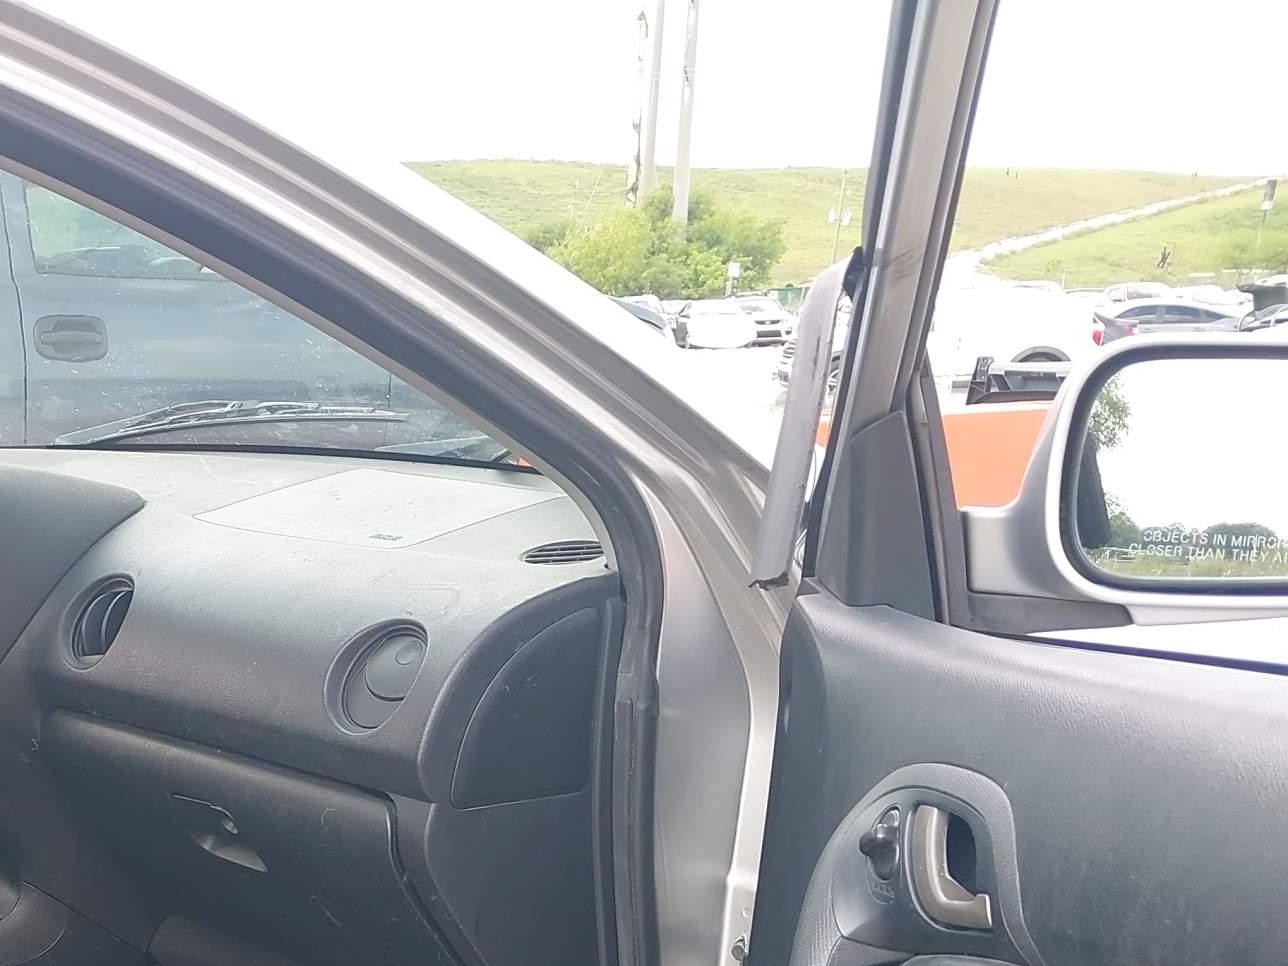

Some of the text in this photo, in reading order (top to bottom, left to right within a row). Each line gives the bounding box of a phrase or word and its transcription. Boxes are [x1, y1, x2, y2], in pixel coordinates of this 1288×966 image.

[1143, 529, 1208, 544] OBJECTS
[1213, 534, 1227, 546] IN
[1128, 543, 1182, 557] CLOSER
[1187, 546, 1226, 561] THAN
[1232, 549, 1270, 563] THEY
